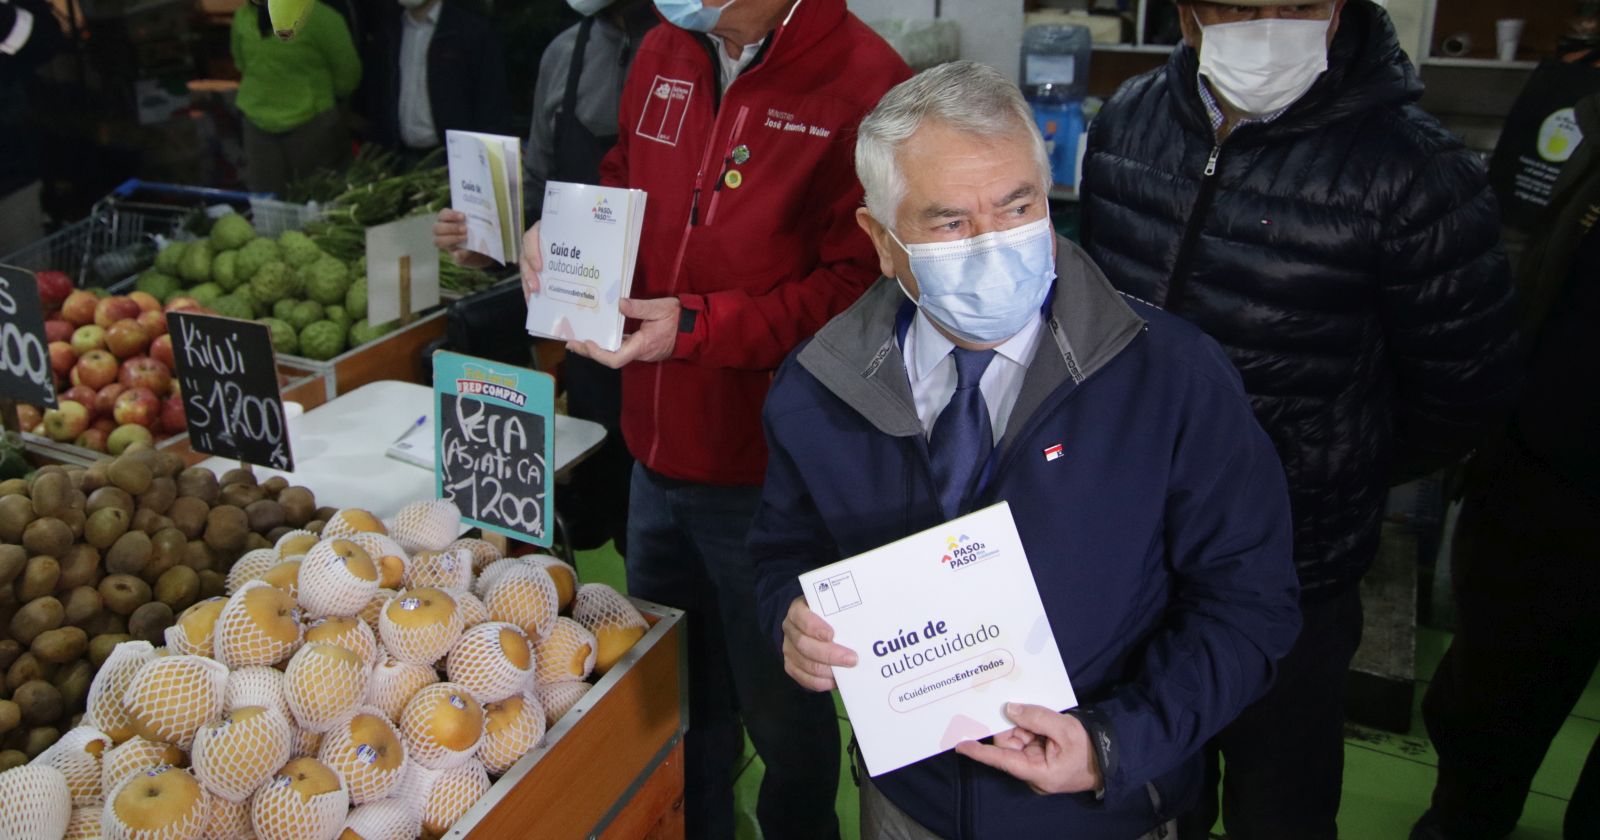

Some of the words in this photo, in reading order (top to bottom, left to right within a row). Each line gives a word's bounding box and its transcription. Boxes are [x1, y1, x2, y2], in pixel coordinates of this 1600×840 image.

[764, 117, 783, 130] José
[550, 242, 569, 257] Guía
[570, 246, 581, 260] de
[548, 260, 600, 280] autocuidado
[953, 542, 980, 558] PASO
[950, 553, 977, 569] PASO
[872, 629, 920, 657] Guía
[923, 620, 948, 639] de
[880, 624, 1000, 678] autocuidado
[898, 658, 1004, 703] #CuidémonosEntreTodos
